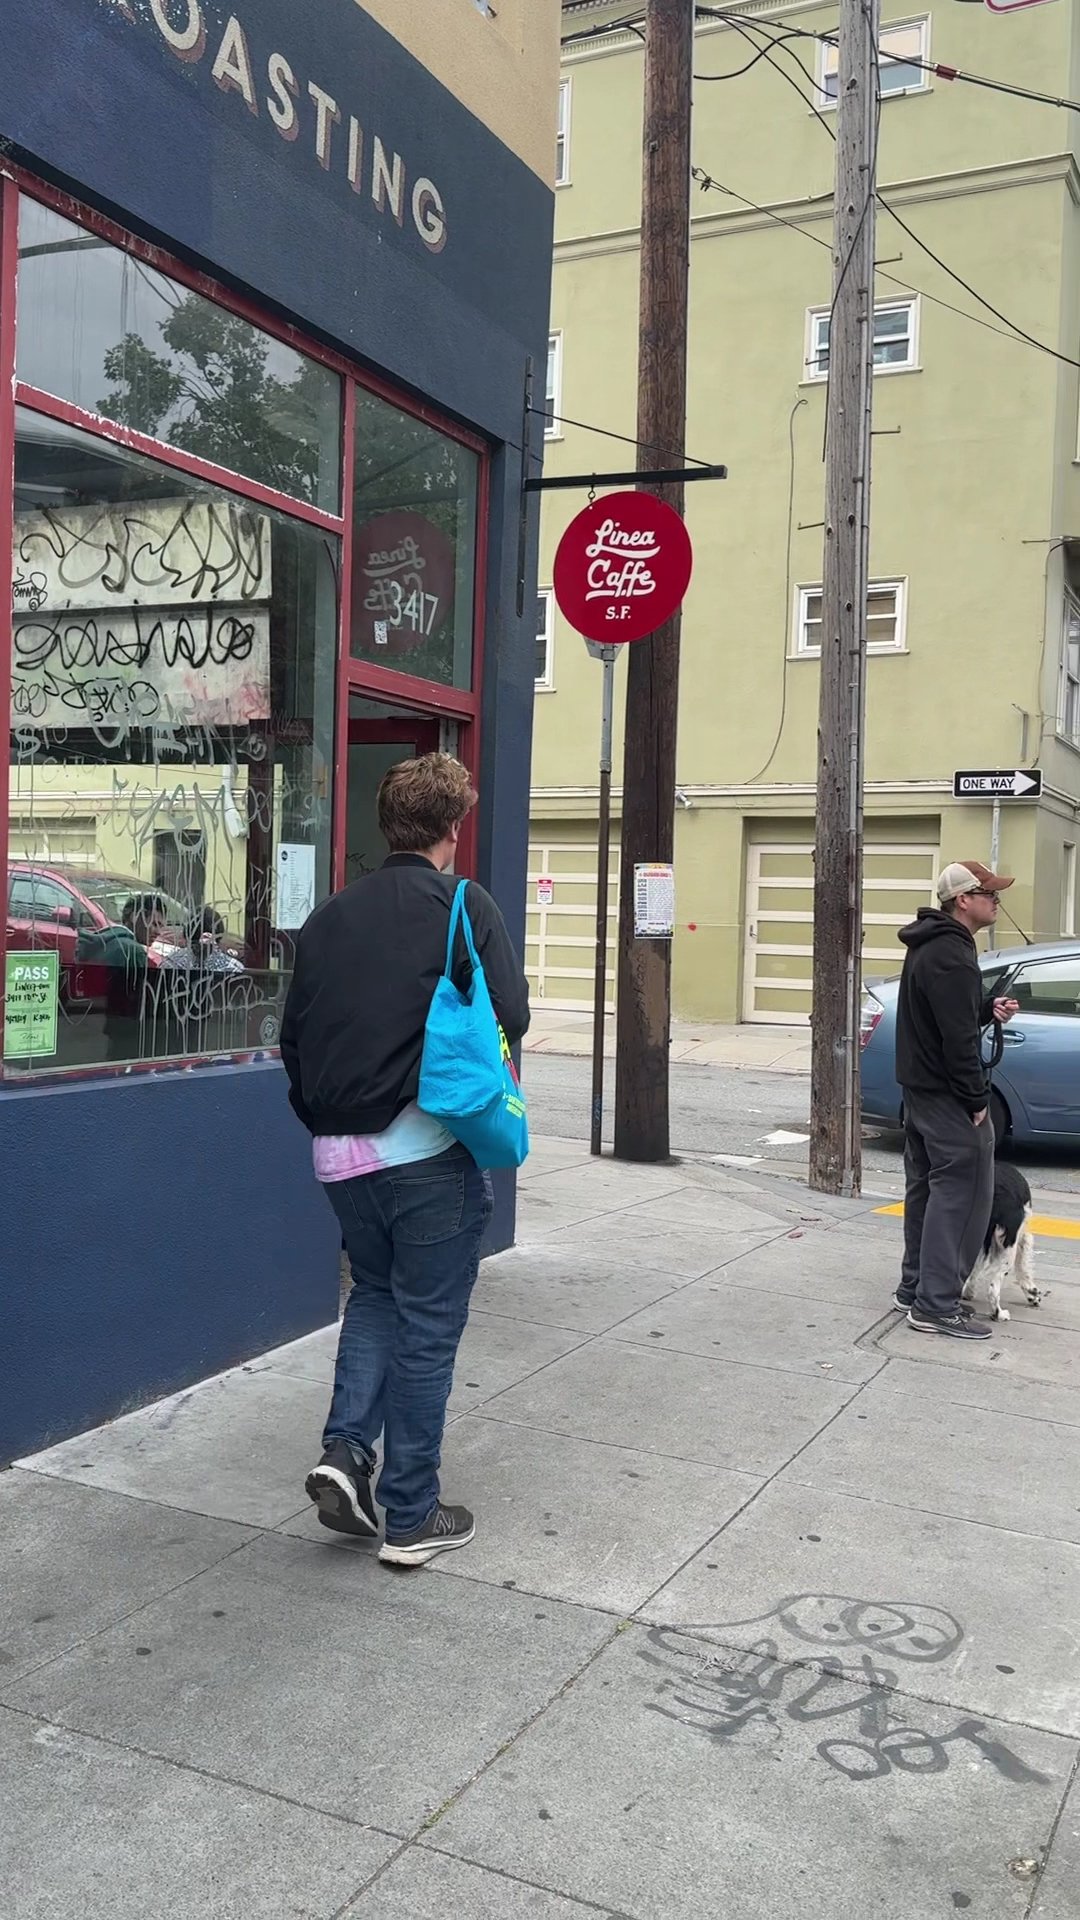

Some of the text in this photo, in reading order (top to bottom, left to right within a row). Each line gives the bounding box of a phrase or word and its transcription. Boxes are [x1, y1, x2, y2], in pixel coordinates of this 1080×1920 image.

[101, 0, 447, 253] OASTING
[585, 518, 661, 559] Linea
[585, 559, 656, 601] Caffe
[389, 580, 439, 636] 3417
[605, 605, 632, 620] S.F.
[962, 777, 1015, 789] ONE WAY
[14, 966, 49, 980] PASS
